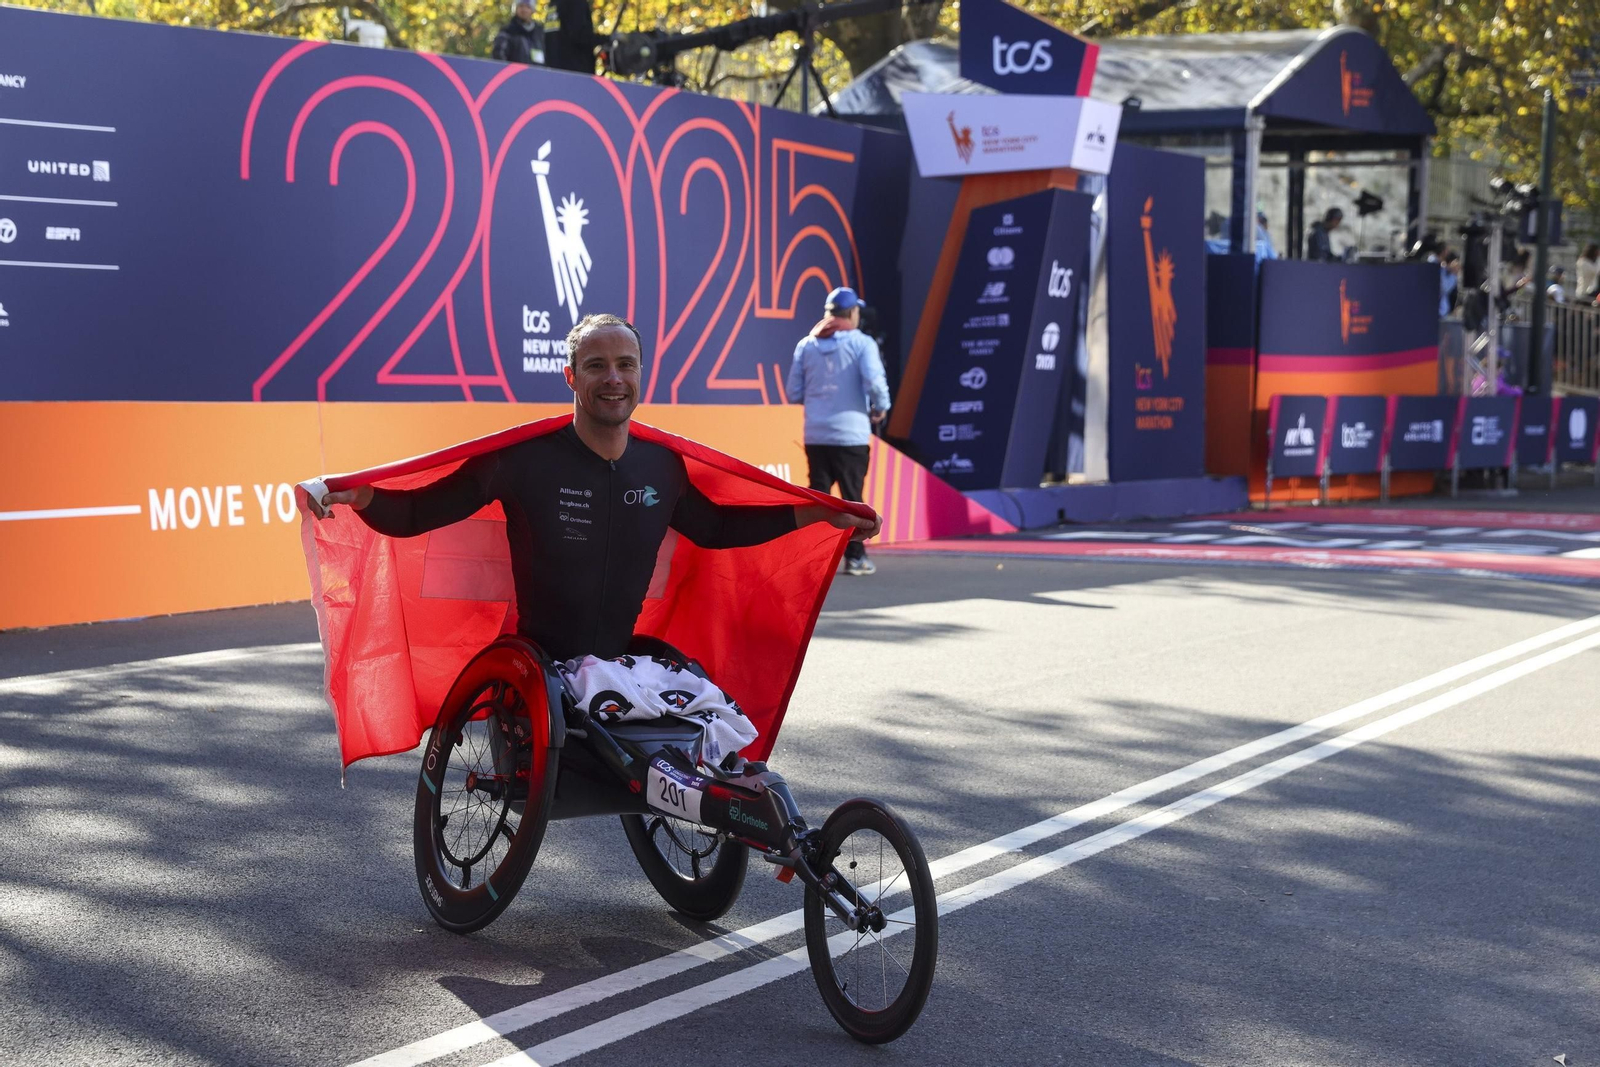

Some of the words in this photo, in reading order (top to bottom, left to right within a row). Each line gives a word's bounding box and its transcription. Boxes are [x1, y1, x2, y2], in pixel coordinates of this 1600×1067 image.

[992, 35, 1053, 76] tcs
[27, 160, 91, 176] UNITED
[240, 40, 864, 403] 2025
[45, 226, 81, 241] ESPN
[1048, 259, 1073, 298] tcs
[523, 304, 551, 334] tcs
[523, 338, 550, 354] NEW
[950, 401, 984, 413] ESPN
[560, 487, 583, 496] Allianz
[148, 485, 245, 531] MOVE
[569, 516, 592, 524] Orthotec
[659, 776, 687, 812] 201
[741, 814, 769, 831] Orthotec
